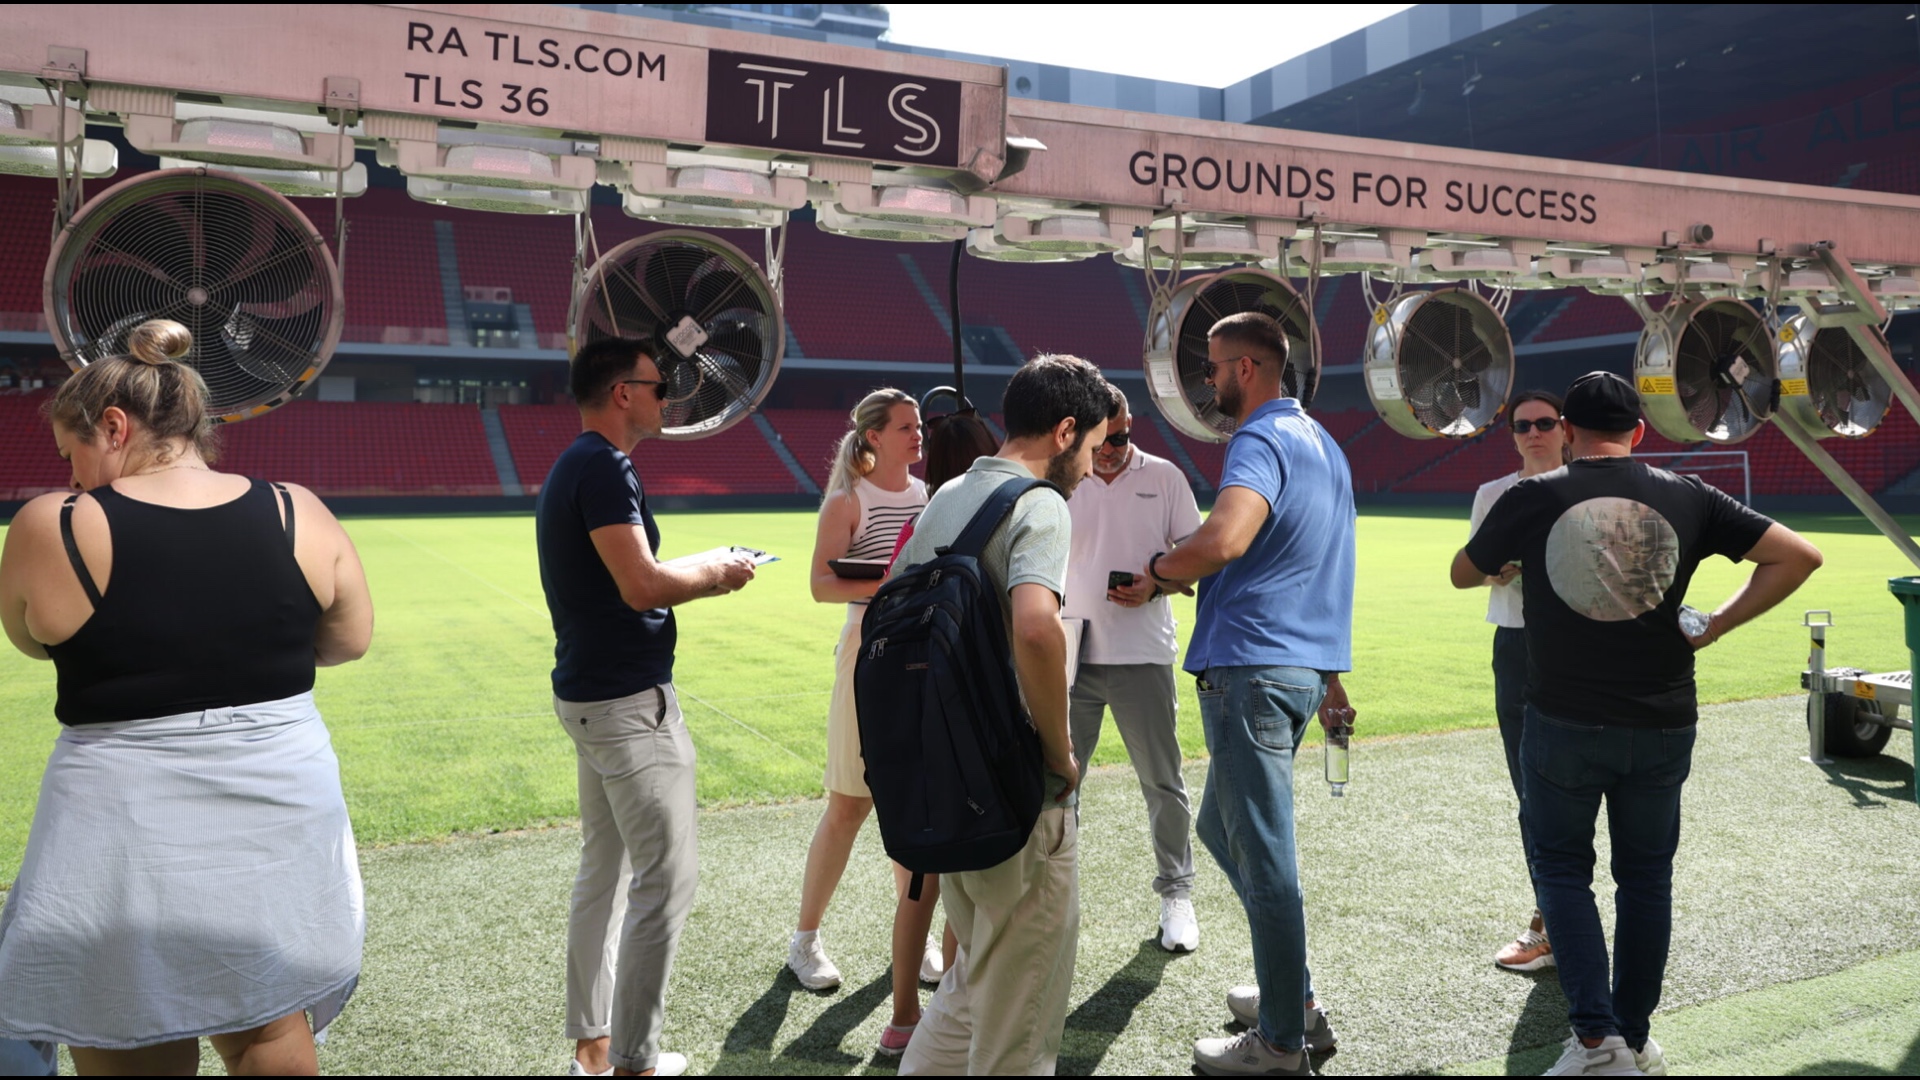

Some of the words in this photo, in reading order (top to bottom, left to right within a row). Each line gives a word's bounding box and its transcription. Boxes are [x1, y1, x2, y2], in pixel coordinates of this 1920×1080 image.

[407, 21, 469, 58] RA
[484, 30, 666, 82] TLS.COM
[404, 72, 483, 110] TLS
[499, 83, 549, 117] 36
[737, 63, 942, 157] TLS
[1128, 150, 1335, 202] GROUNDS
[1352, 171, 1427, 209] FOR
[1444, 180, 1597, 225] SUCCESS
